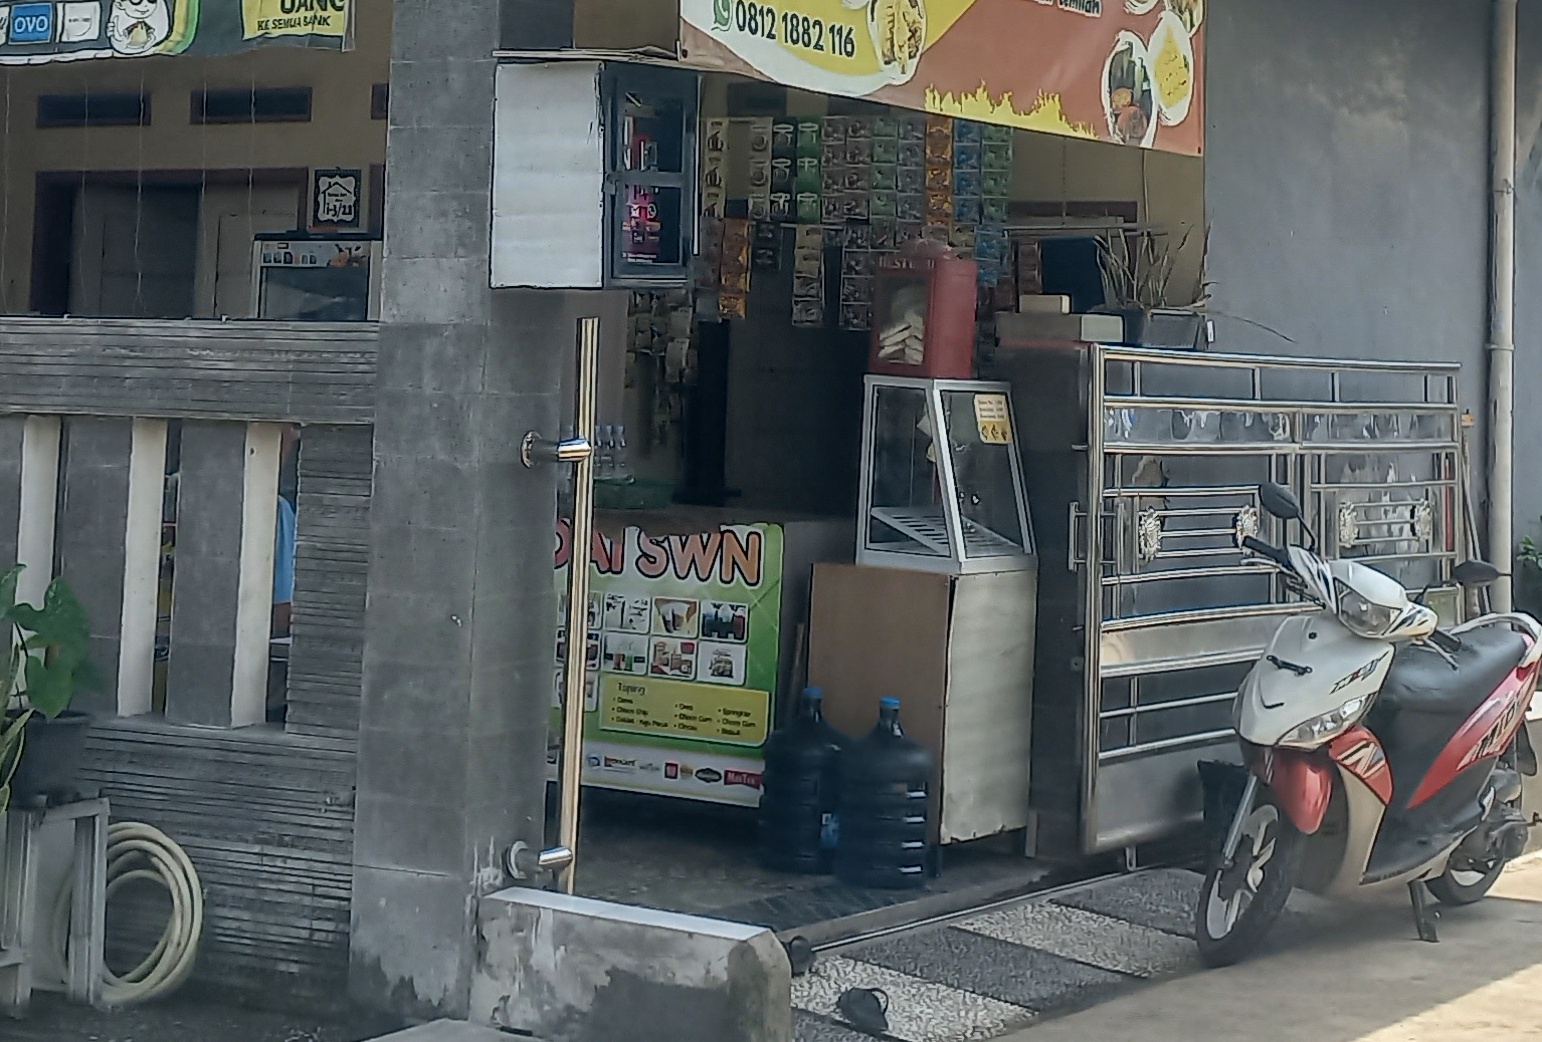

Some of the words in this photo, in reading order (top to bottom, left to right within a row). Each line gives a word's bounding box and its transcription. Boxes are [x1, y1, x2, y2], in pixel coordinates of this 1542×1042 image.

[14, 15, 48, 33] OVO
[303, 15, 331, 28] BANK
[736, 0, 776, 40] 0812
[782, 12, 824, 52] 1882
[828, 24, 855, 57] 116
[635, 527, 761, 586] SWN
